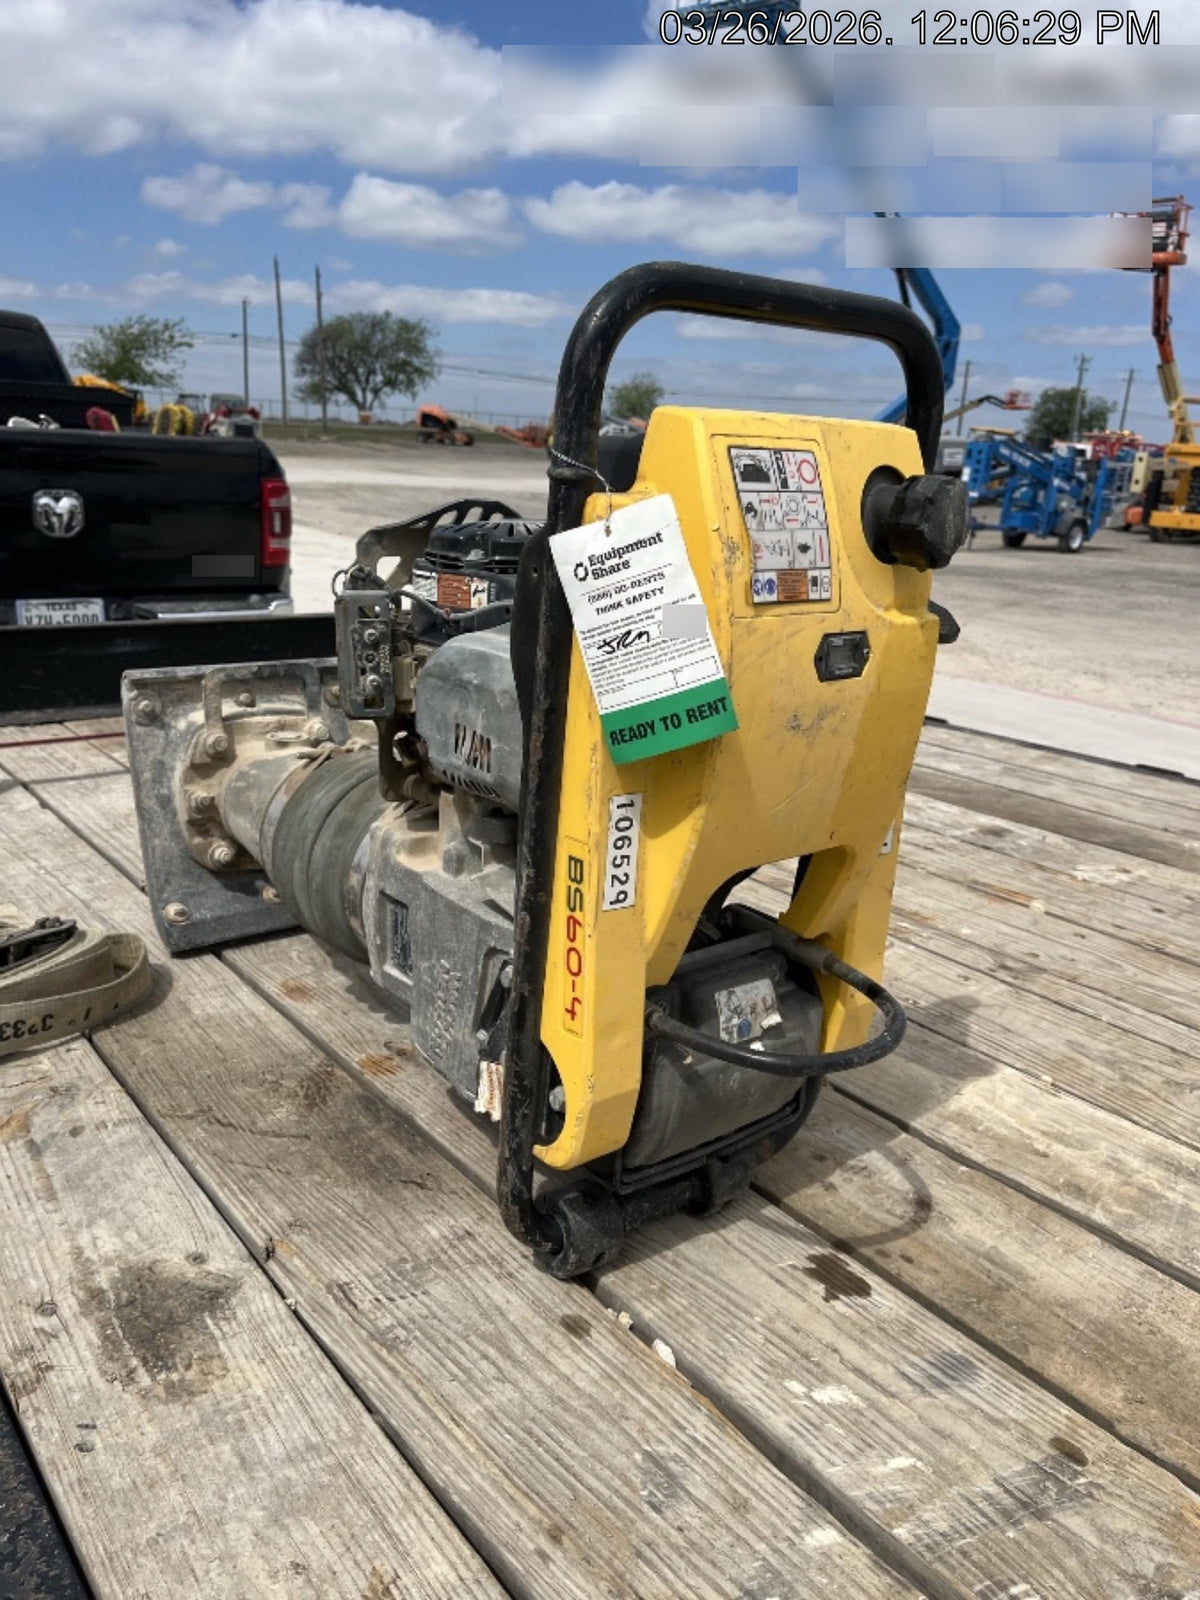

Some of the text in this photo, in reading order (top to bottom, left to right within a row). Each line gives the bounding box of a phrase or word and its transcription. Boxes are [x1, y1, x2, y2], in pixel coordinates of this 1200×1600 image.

[588, 532, 664, 568] Equipment
[591, 560, 631, 581] Share
[609, 696, 729, 747] READY TO RENT
[609, 800, 635, 905] 106529
[565, 853, 585, 1022] BS60-4
